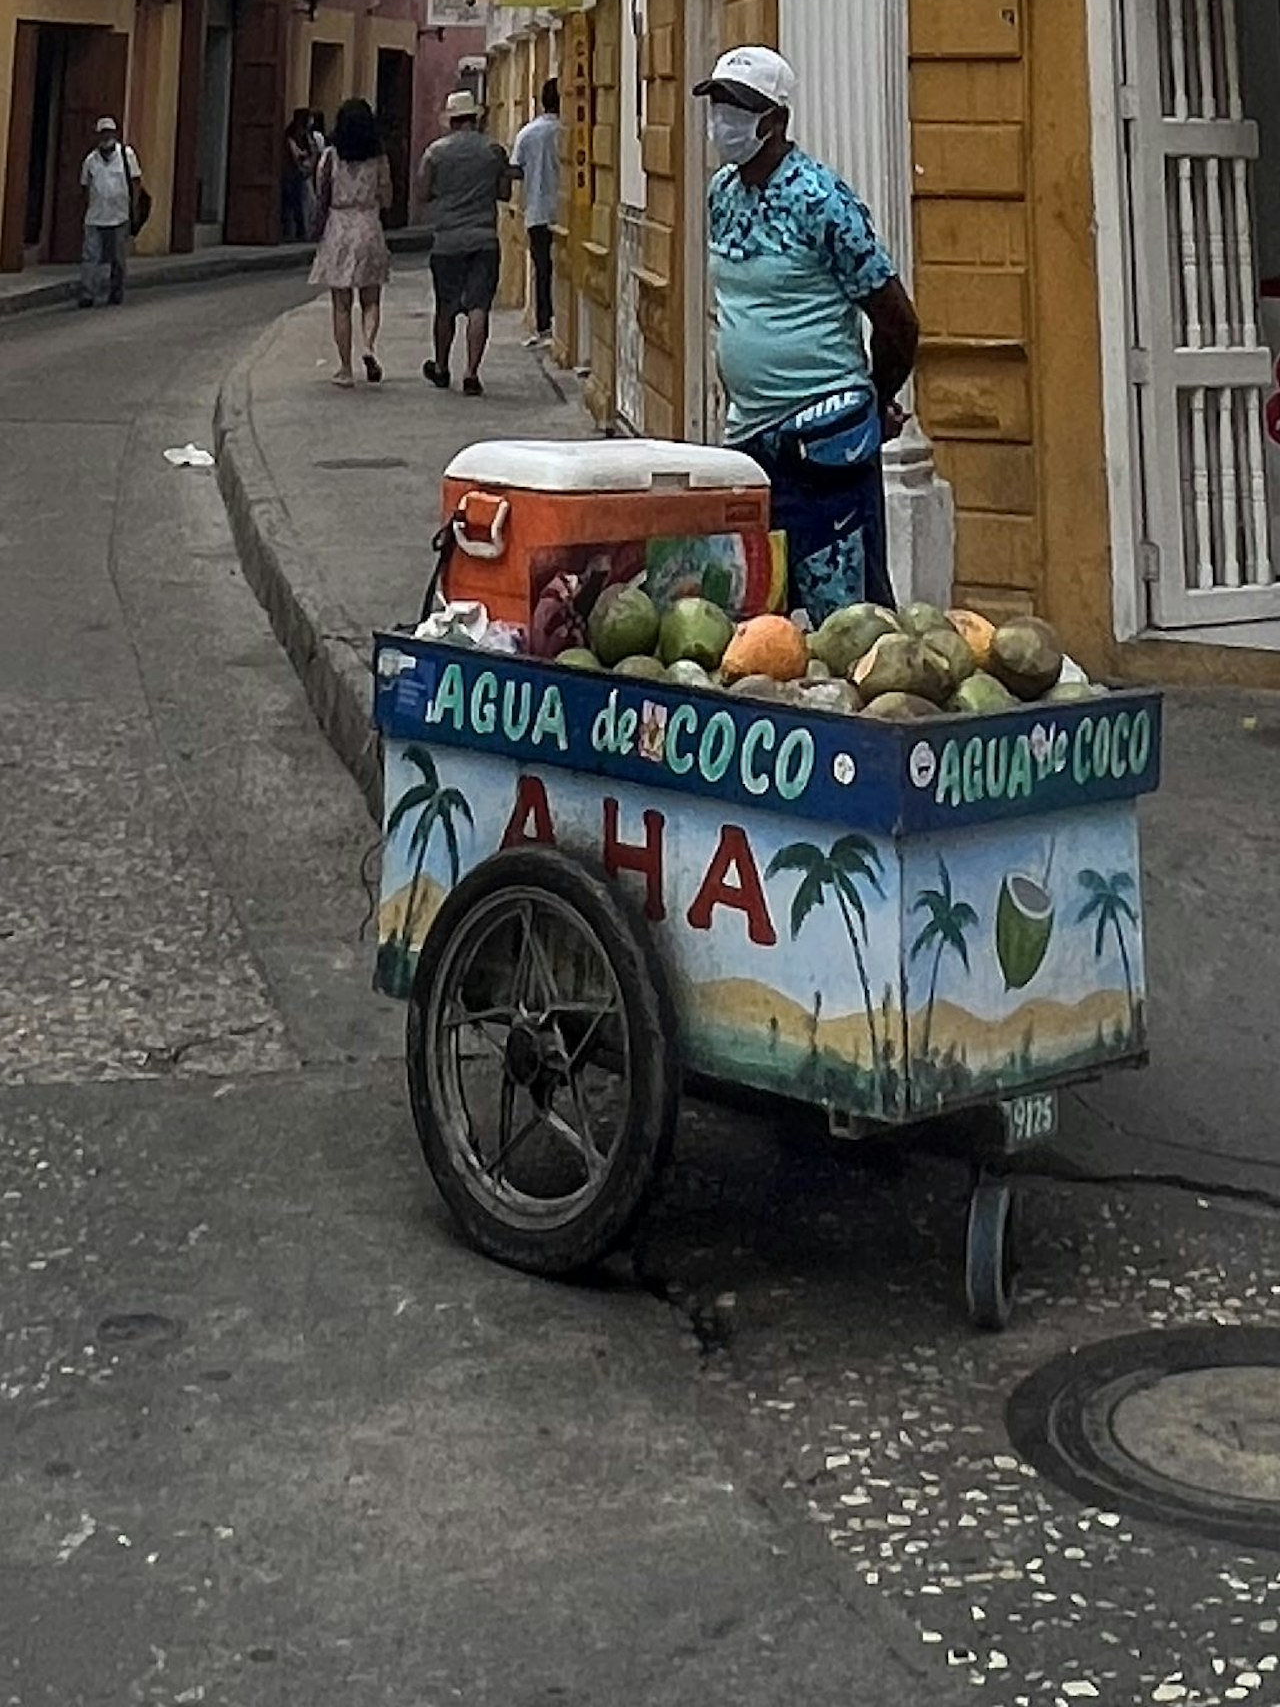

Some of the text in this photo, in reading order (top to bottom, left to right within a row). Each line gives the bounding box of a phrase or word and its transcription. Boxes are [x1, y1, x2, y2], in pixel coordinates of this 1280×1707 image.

[429, 663, 816, 801] AGUA de COCO
[934, 734, 1033, 808] AGUA
[1072, 708, 1151, 786] COCO
[498, 773, 778, 947] AHA
